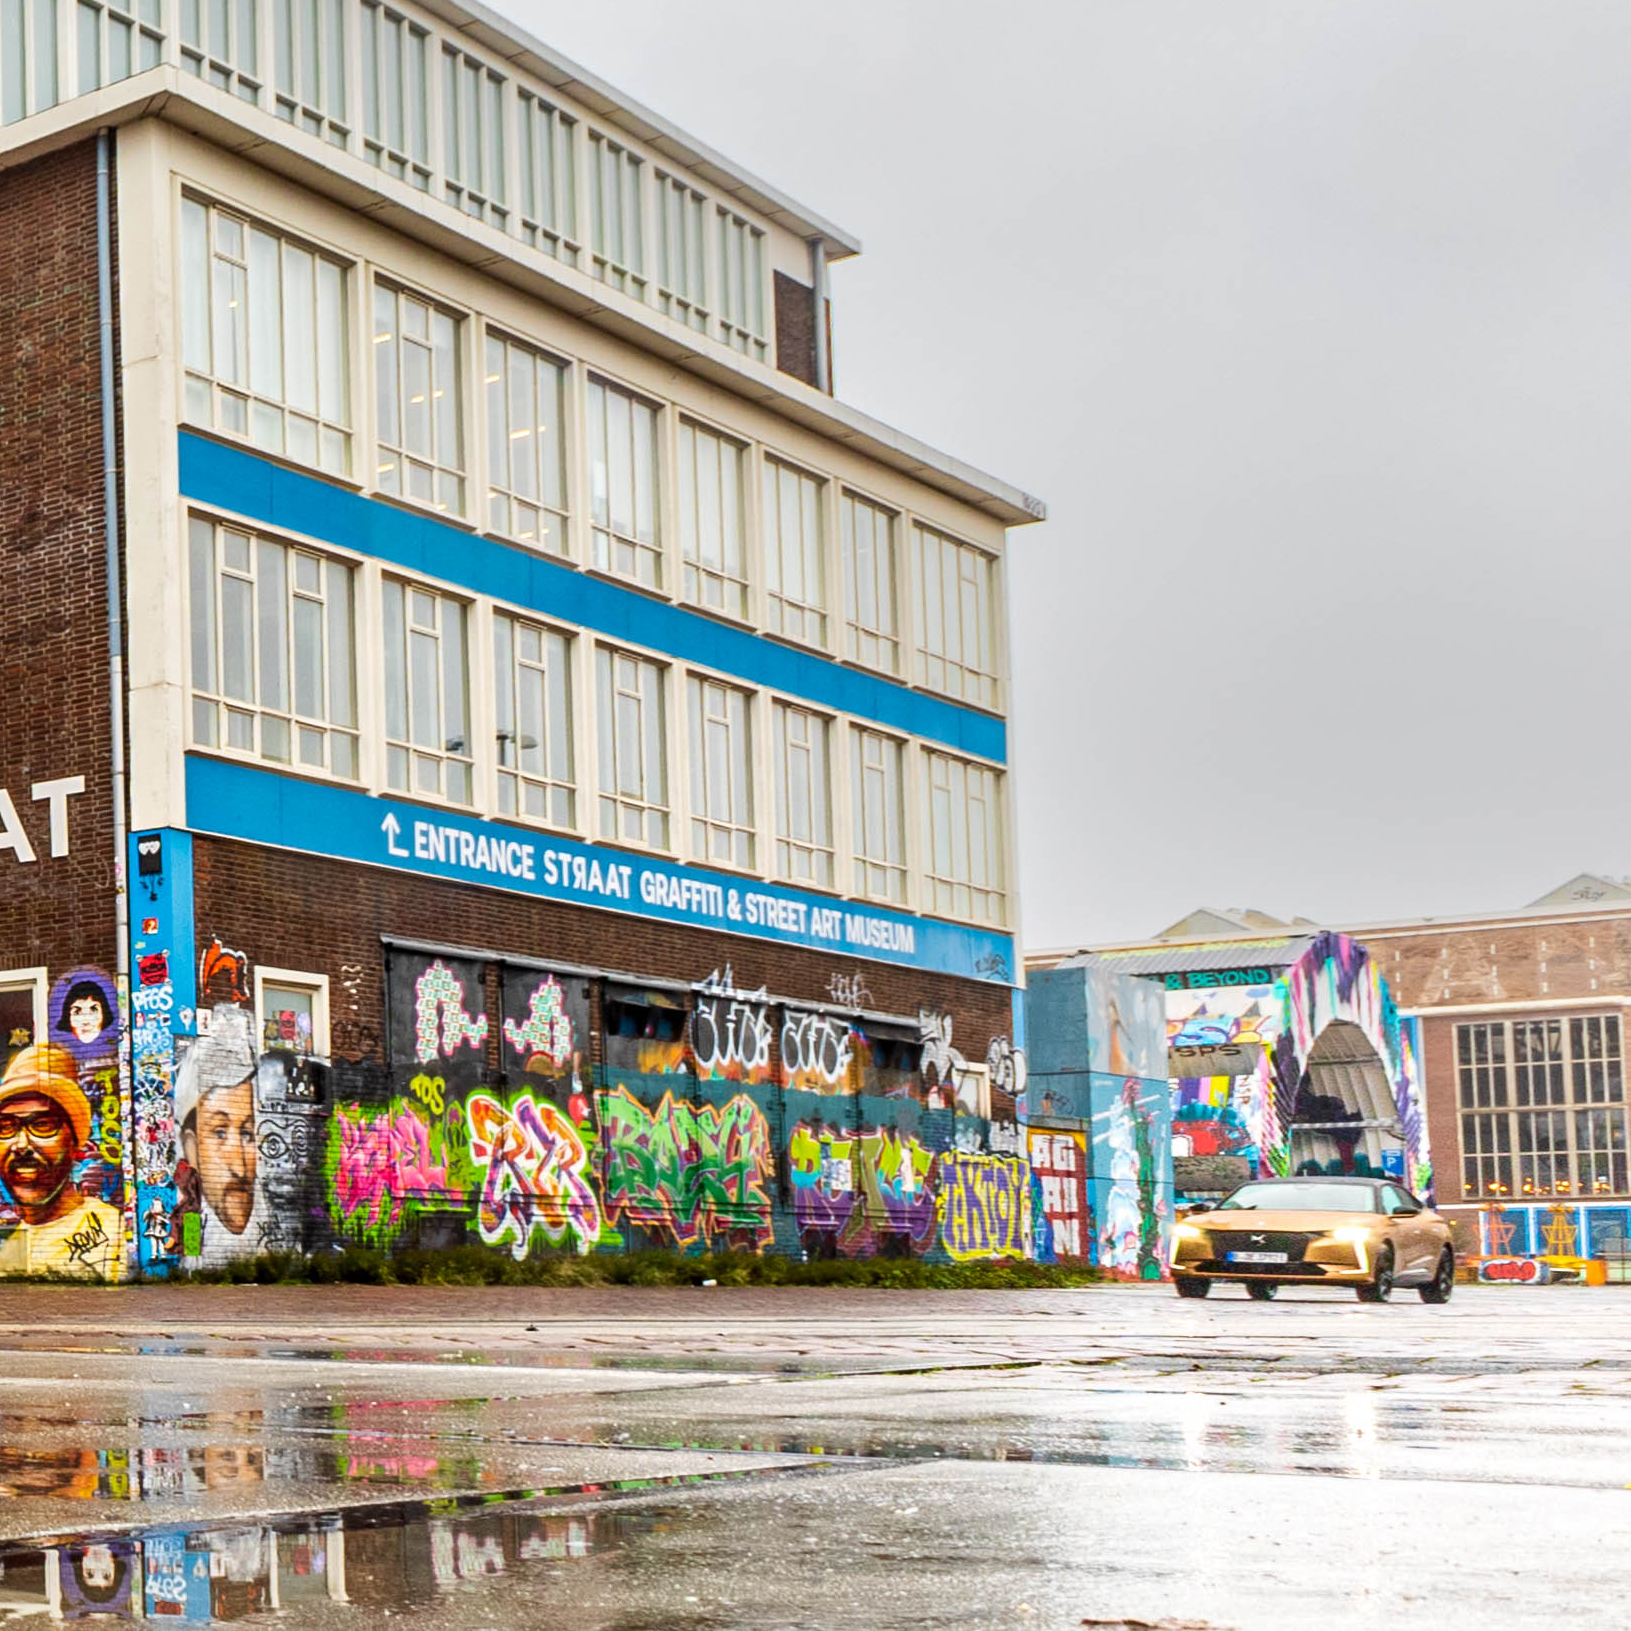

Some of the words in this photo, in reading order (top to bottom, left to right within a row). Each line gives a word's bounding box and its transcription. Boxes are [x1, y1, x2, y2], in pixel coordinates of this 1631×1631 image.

[414, 820, 536, 881] ENTRANCE
[543, 849, 631, 900] STRAAT
[640, 870, 724, 918] GRAFFITI
[727, 888, 742, 919] &
[745, 892, 807, 933] STREET
[811, 904, 843, 941] ART
[845, 914, 915, 954] MUSEUM
[1187, 969, 1270, 987] BEYOND
